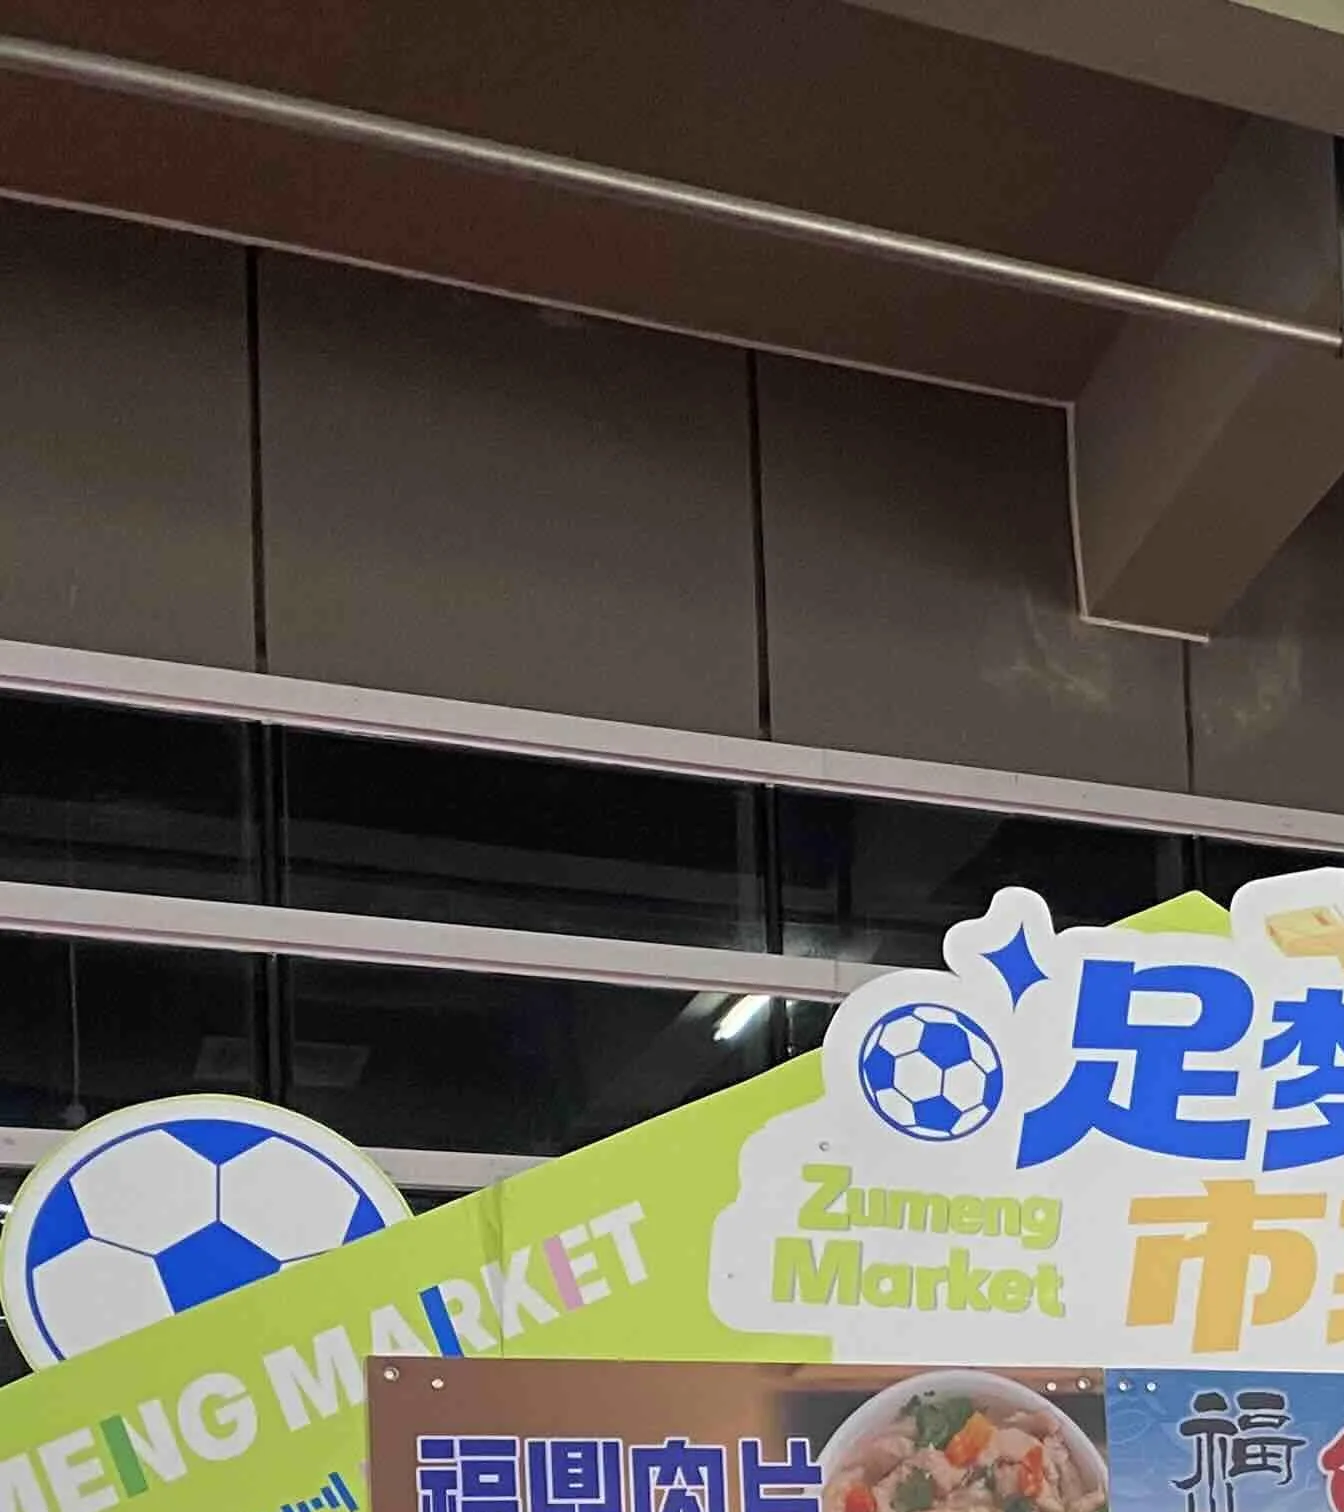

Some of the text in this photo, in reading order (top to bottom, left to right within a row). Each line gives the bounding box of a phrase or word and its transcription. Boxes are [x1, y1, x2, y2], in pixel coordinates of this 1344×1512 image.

[798, 1163, 1064, 1249] Zumeng
[264, 1202, 647, 1431] MARKET
[771, 1238, 1066, 1318] Market
